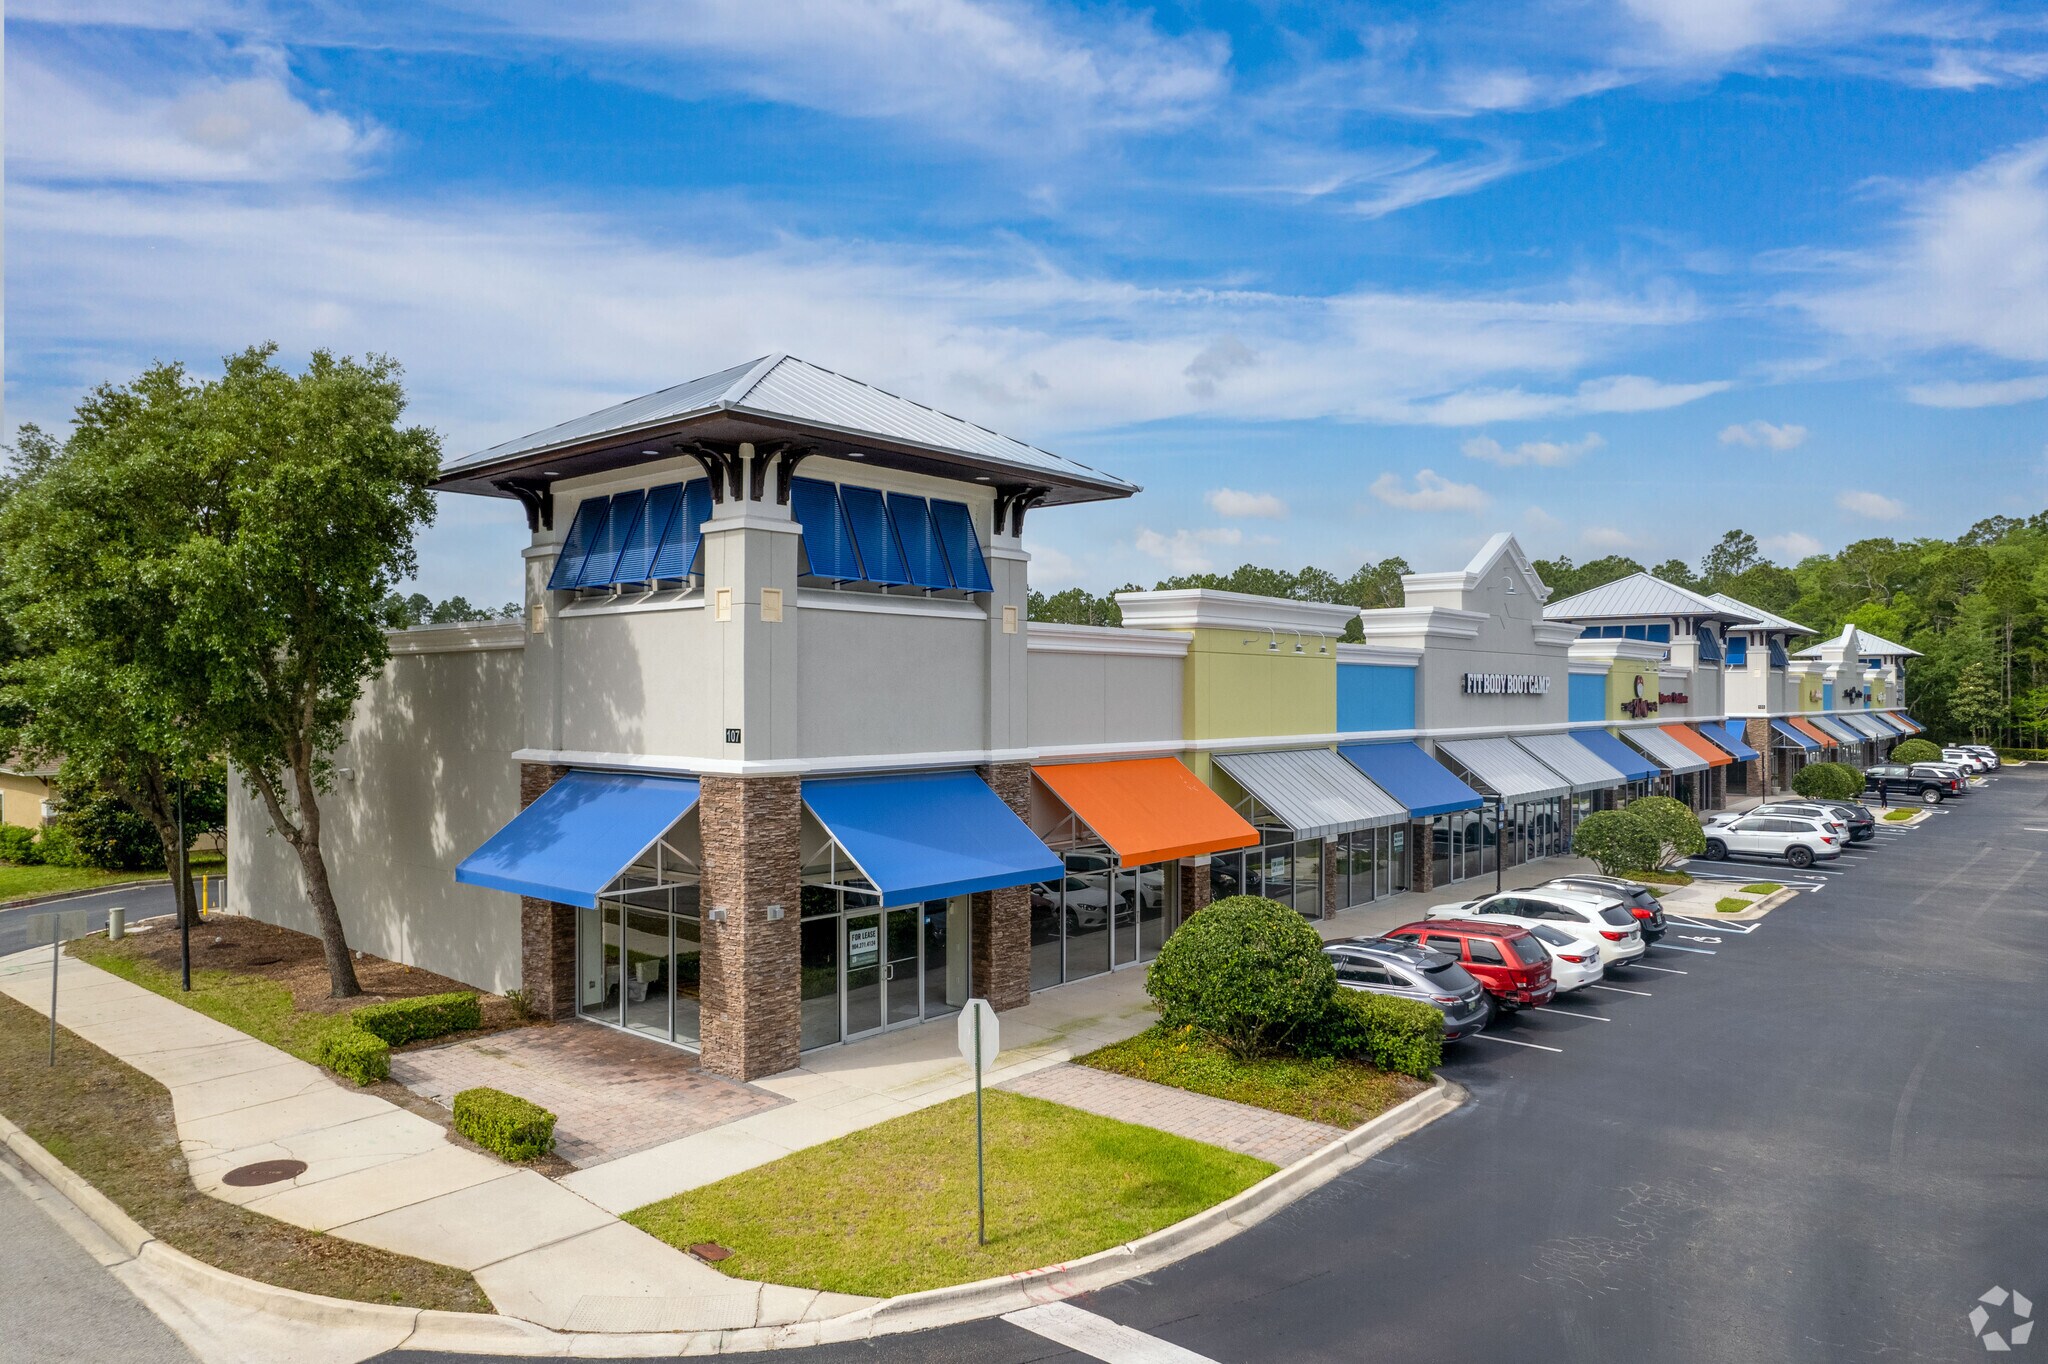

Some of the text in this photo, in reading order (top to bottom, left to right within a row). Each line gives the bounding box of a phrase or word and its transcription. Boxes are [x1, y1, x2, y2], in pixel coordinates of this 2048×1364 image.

[1466, 673, 1550, 694] FIT BODY BOOT CAMP
[727, 730, 740, 742] 107
[852, 930, 876, 941] FOR LEASE
